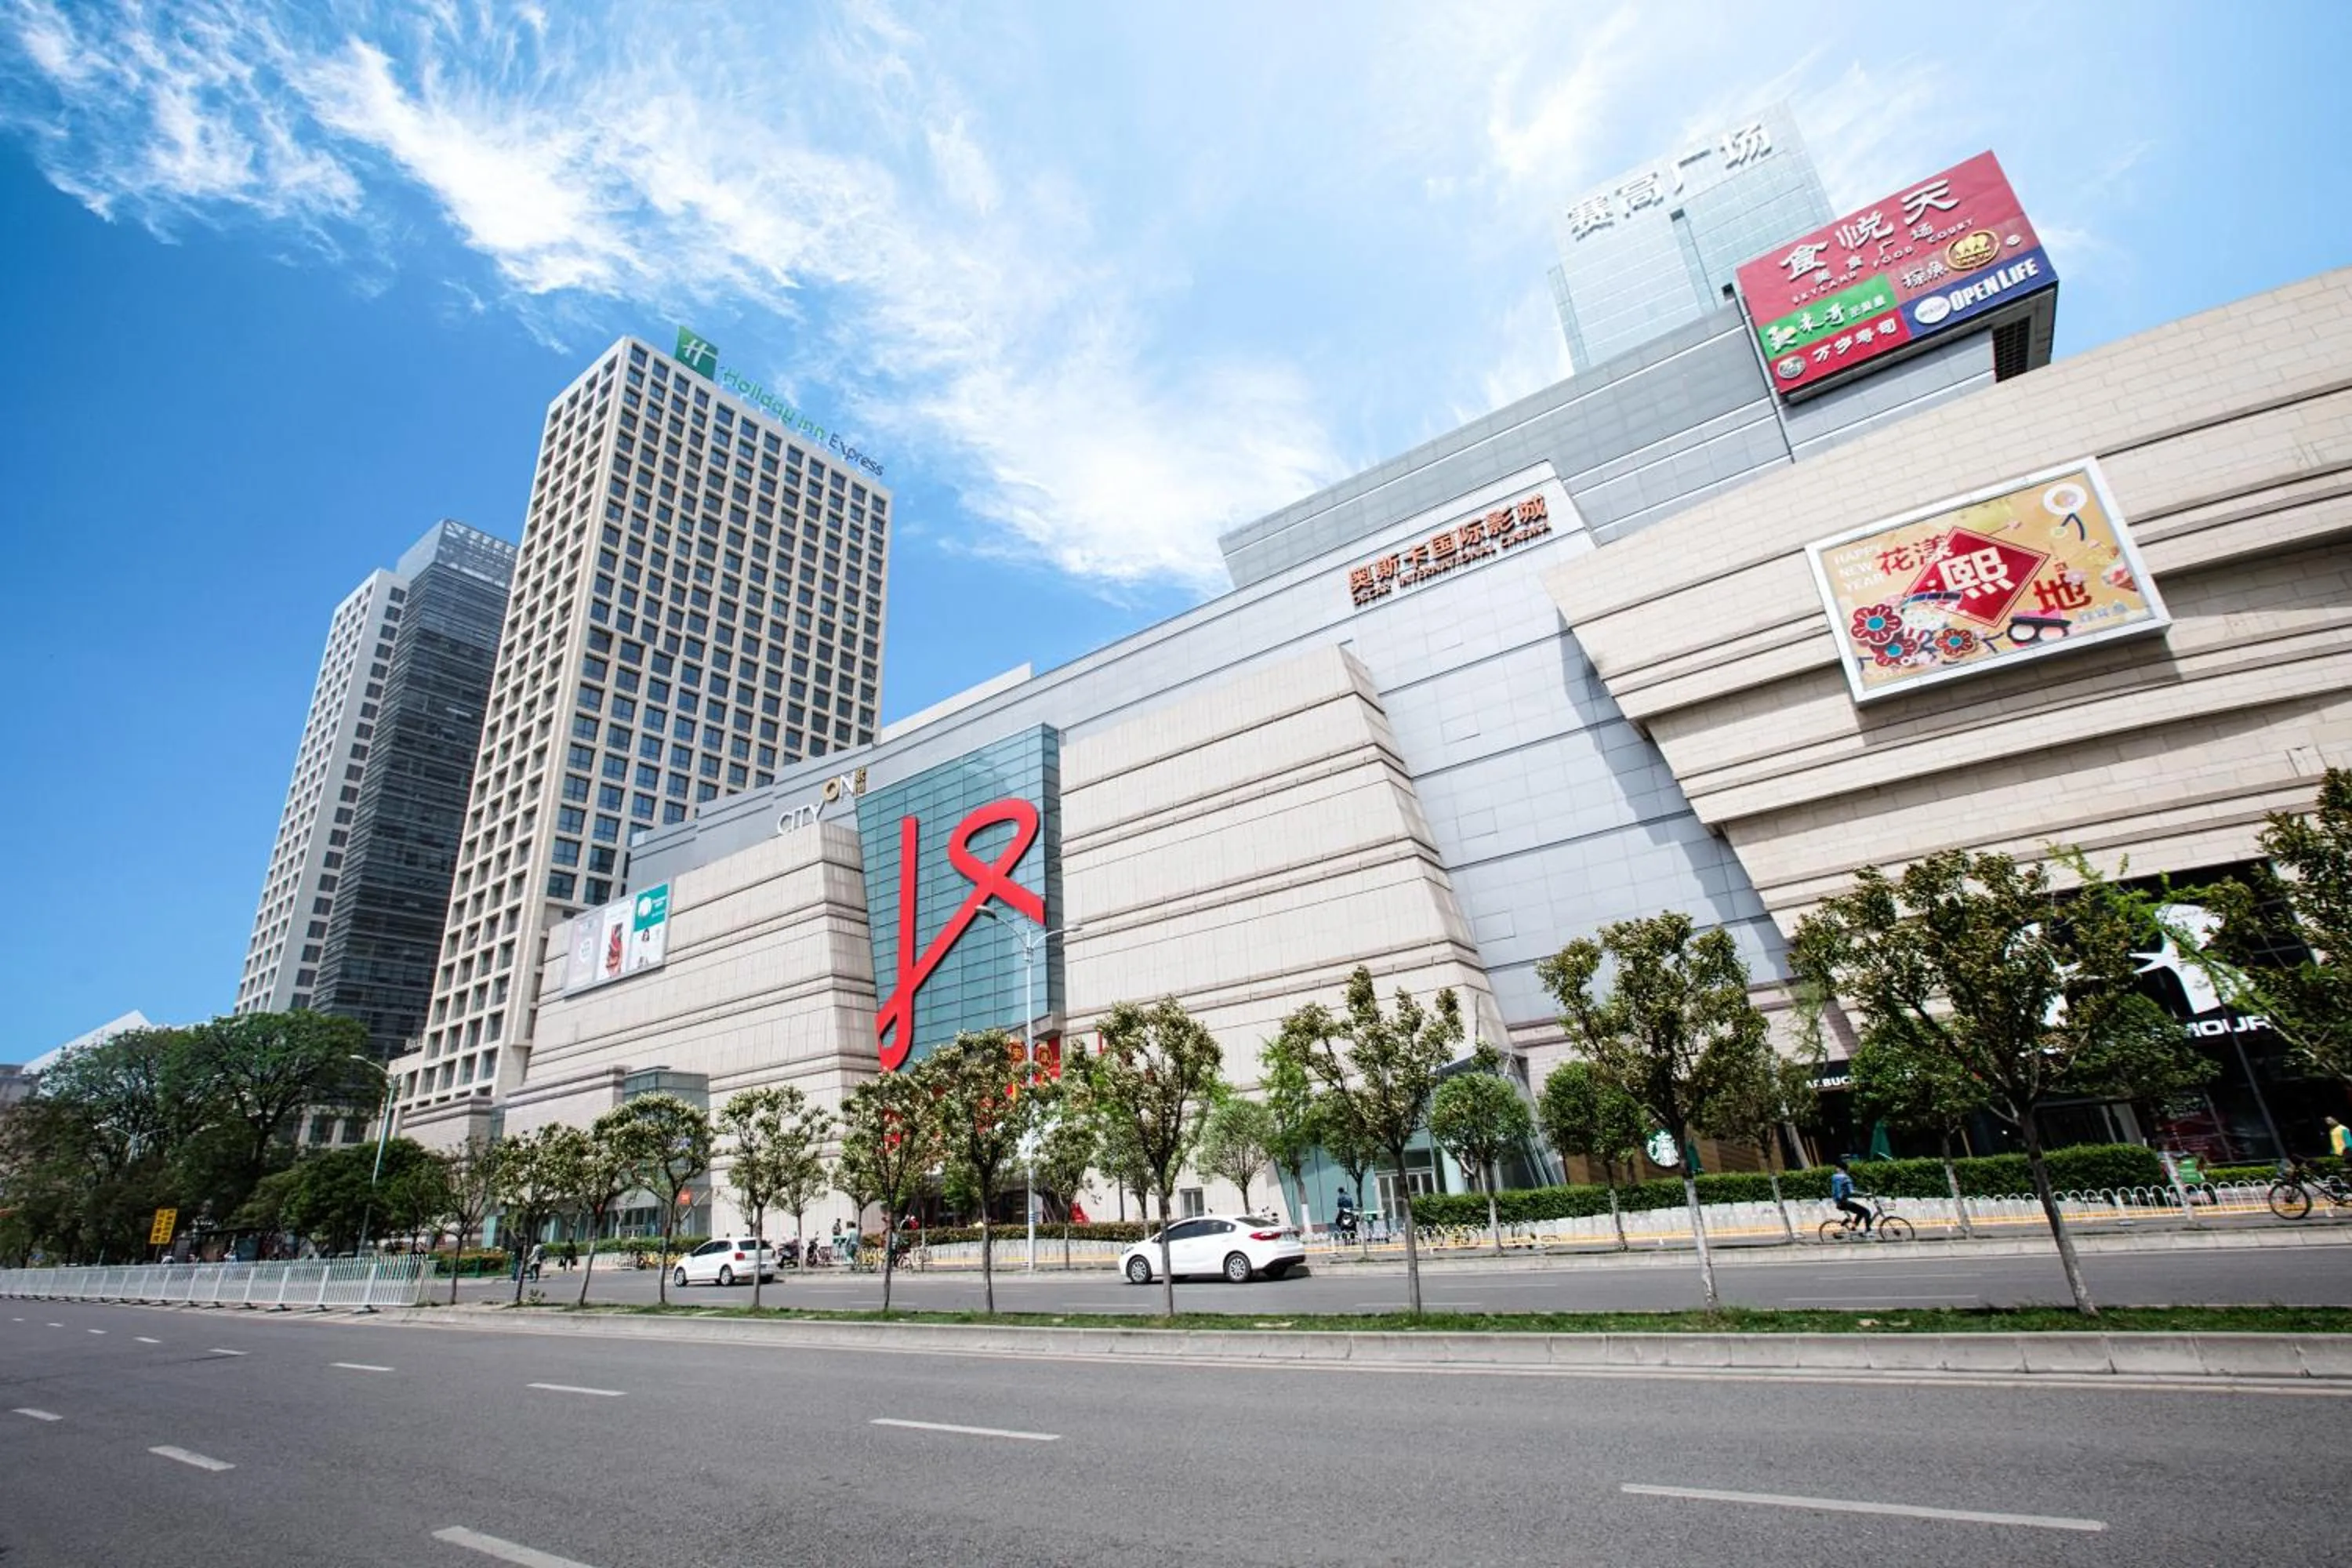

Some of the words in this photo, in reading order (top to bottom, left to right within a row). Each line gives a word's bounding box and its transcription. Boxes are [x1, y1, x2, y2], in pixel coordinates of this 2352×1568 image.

[1566, 122, 1772, 242] 赛高广场
[1791, 271, 1857, 304] SKYLAND
[1871, 245, 1914, 268] FOOD
[1927, 218, 1974, 245] COURT
[1813, 222, 1935, 285] 美食广场
[723, 367, 796, 425] Holiday
[798, 414, 827, 441] Inn
[829, 432, 884, 477] Express
[1348, 492, 1549, 594] 奥斯卡国际影城
